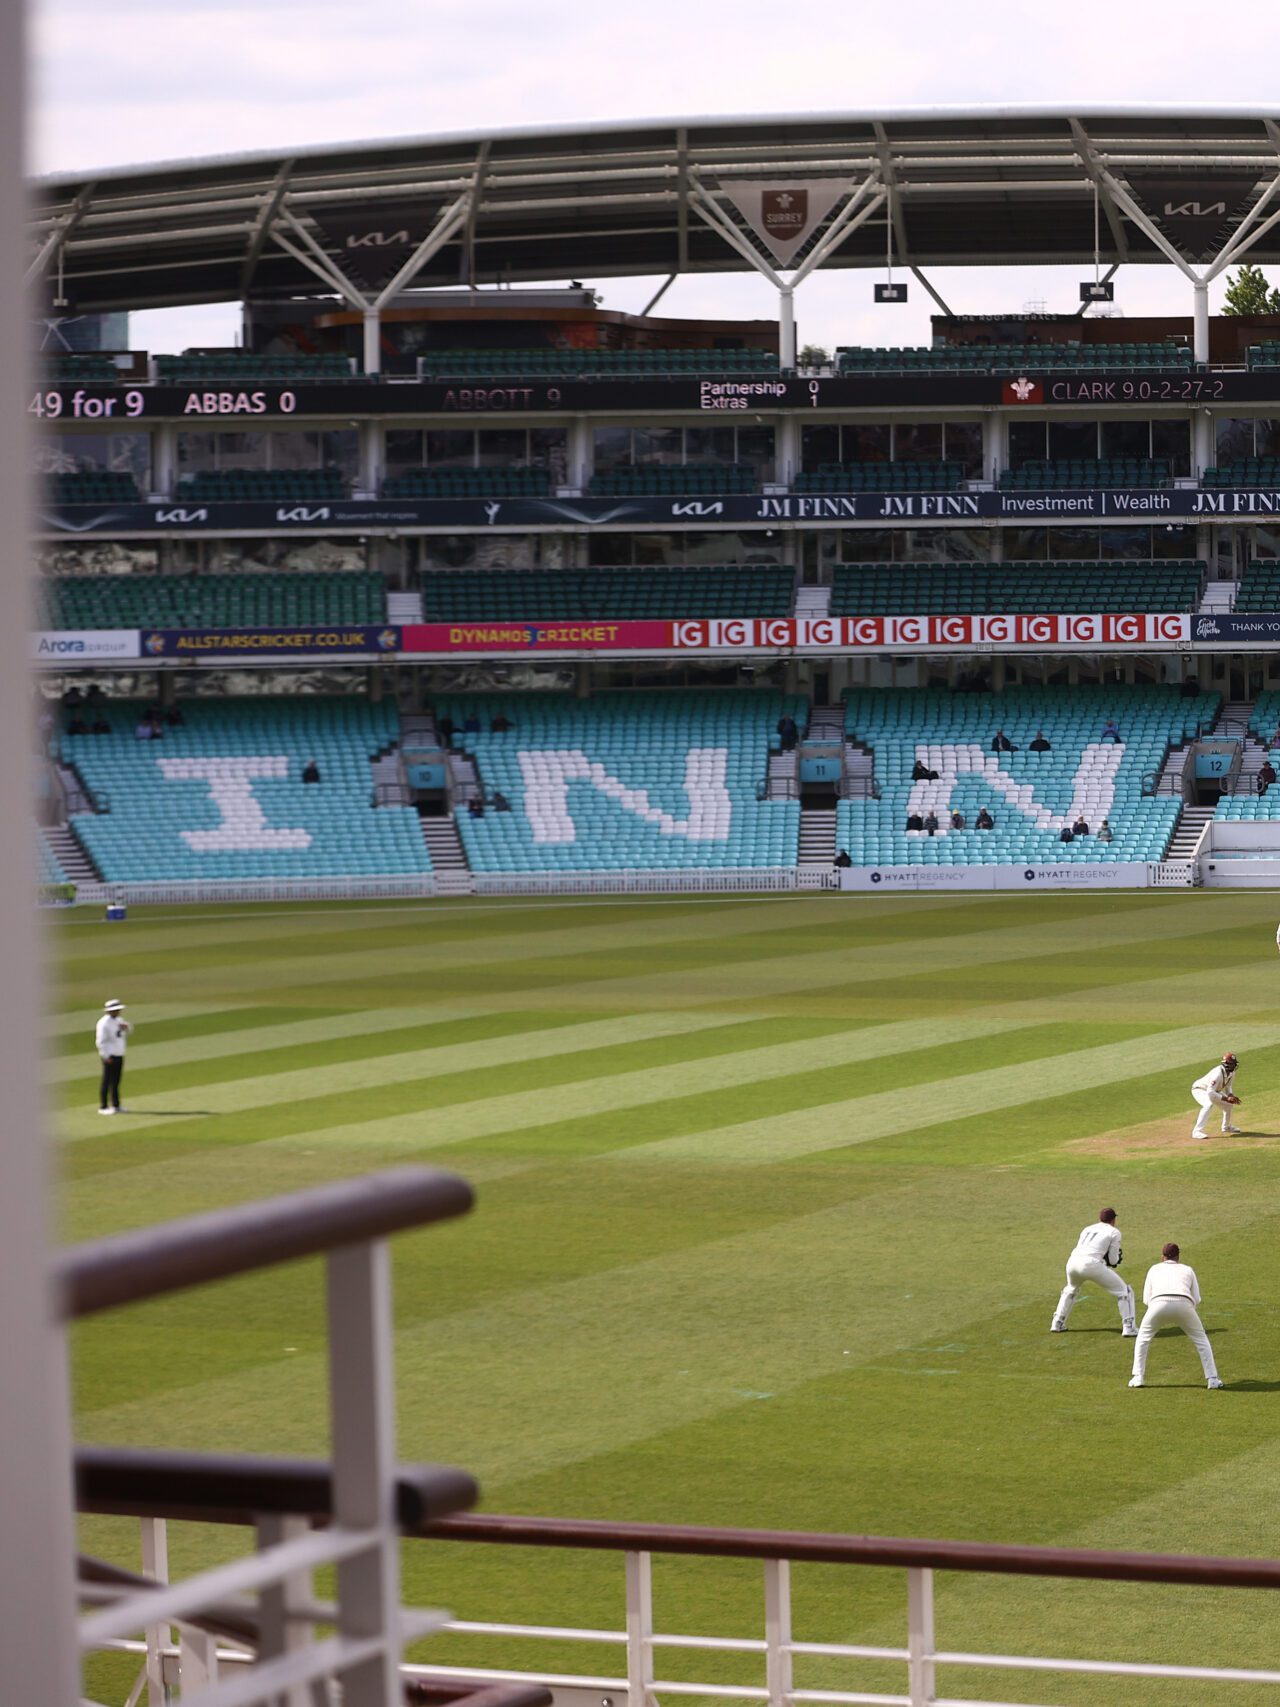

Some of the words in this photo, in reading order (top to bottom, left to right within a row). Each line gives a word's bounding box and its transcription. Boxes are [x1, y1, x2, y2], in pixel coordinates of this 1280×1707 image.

[444, 388, 534, 411] ABBOTT
[547, 388, 561, 409] 9
[701, 381, 786, 397] Partnership
[809, 381, 819, 394] 0
[1052, 382, 1116, 400] CLARK
[1122, 381, 1224, 399] 9.0-2-27-2
[72, 391, 116, 417] for
[125, 391, 144, 417] 9
[184, 392, 266, 414] ABBAS
[280, 392, 296, 414] 0
[701, 395, 748, 409] Extras
[810, 395, 818, 408] 1
[757, 499, 791, 518] JM
[799, 497, 856, 517] FINN
[880, 497, 914, 516] JM
[920, 496, 979, 515] FINN
[1002, 495, 1094, 511] Investment
[1113, 494, 1170, 510] Wealth
[1192, 493, 1226, 512] JM
[450, 628, 531, 643] DYNAMOS
[536, 626, 618, 642] CRICKET
[673, 622, 702, 646] IG
[717, 621, 745, 645] IG
[761, 620, 790, 643] IG
[805, 620, 833, 644] IG
[848, 619, 878, 643] IG
[893, 618, 920, 642] IG
[936, 617, 965, 642] IG
[980, 617, 1008, 641] IG
[1022, 616, 1050, 641] IG
[1066, 616, 1094, 640] IG
[1109, 616, 1138, 641] IG
[1153, 615, 1182, 640] IG
[1231, 623, 1264, 631] THANK
[39, 638, 84, 652] Arora
[176, 632, 365, 649] ALLSTARSCRICKET.CO.UK
[815, 765, 827, 775] 11
[1209, 761, 1222, 771] 12
[884, 873, 918, 882] HYATT
[920, 872, 965, 881] REGENCY
[1038, 870, 1071, 879] HYATT
[1073, 870, 1117, 879] REGENCY
